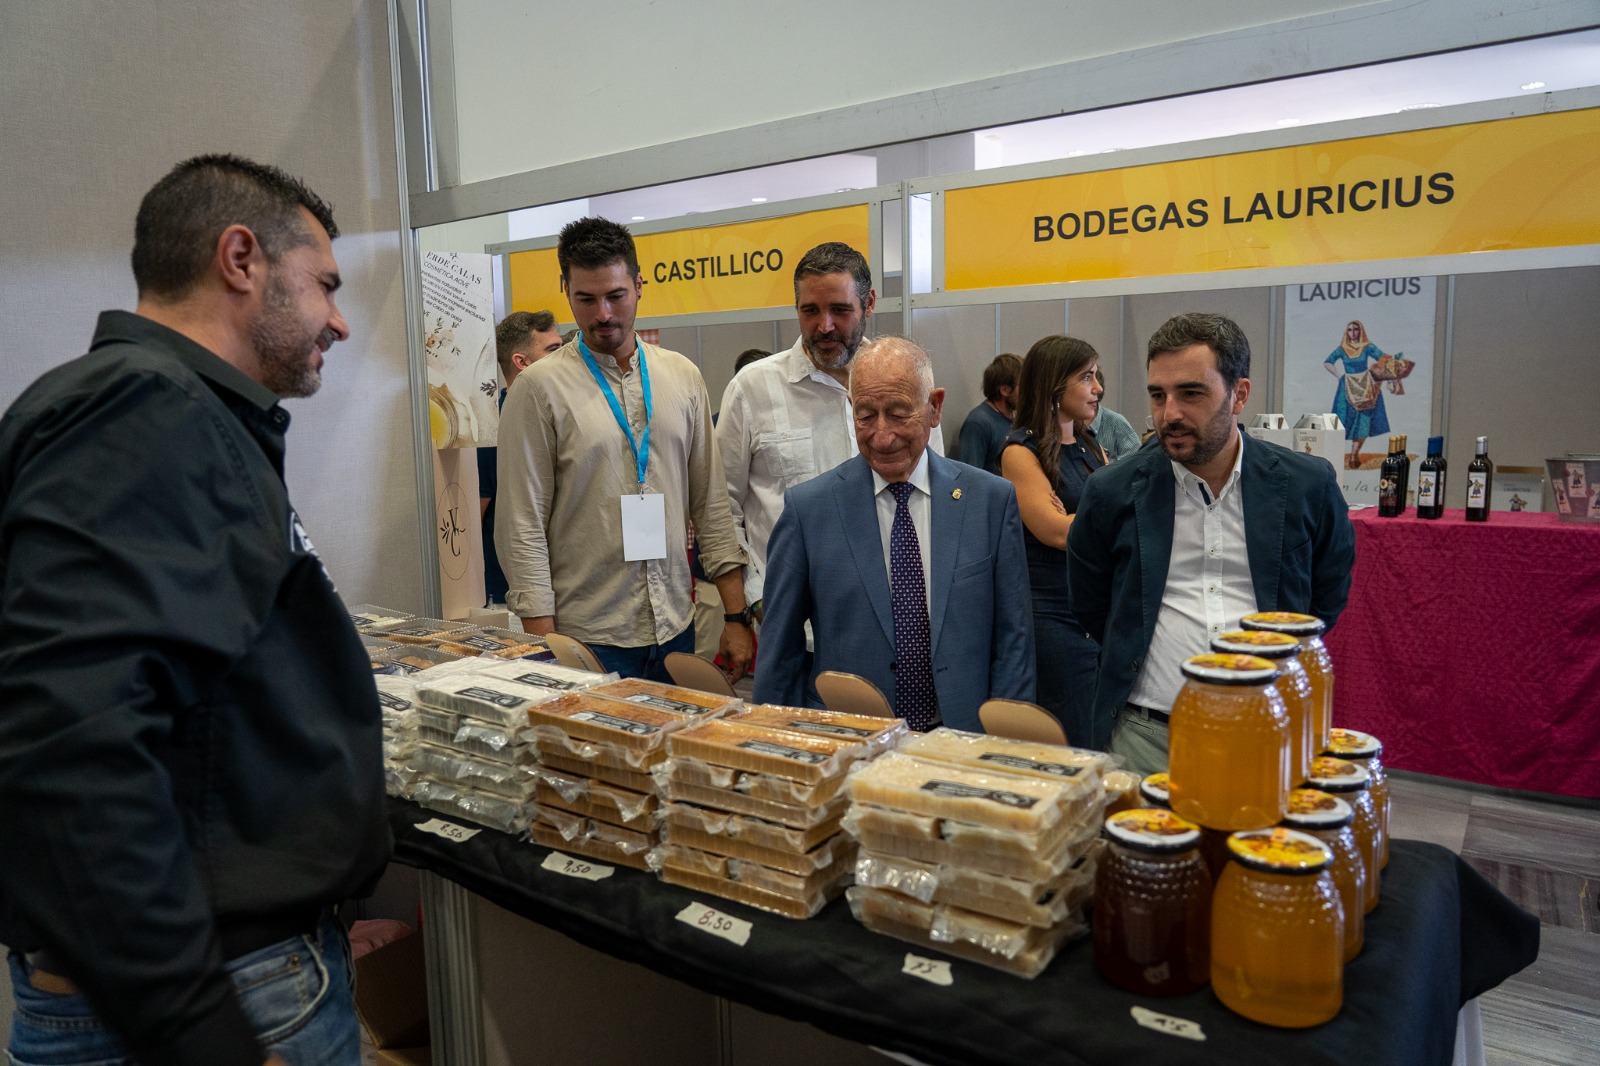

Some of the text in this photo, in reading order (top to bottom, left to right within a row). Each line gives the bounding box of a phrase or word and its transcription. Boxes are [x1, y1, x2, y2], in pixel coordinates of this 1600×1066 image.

[1033, 171, 1456, 243] BODEGAS LAURICIUS
[451, 264, 482, 284] CALAS
[653, 248, 784, 284] CASTILLICO
[454, 277, 470, 288] AOVE
[1299, 276, 1421, 303] LAURICIUS
